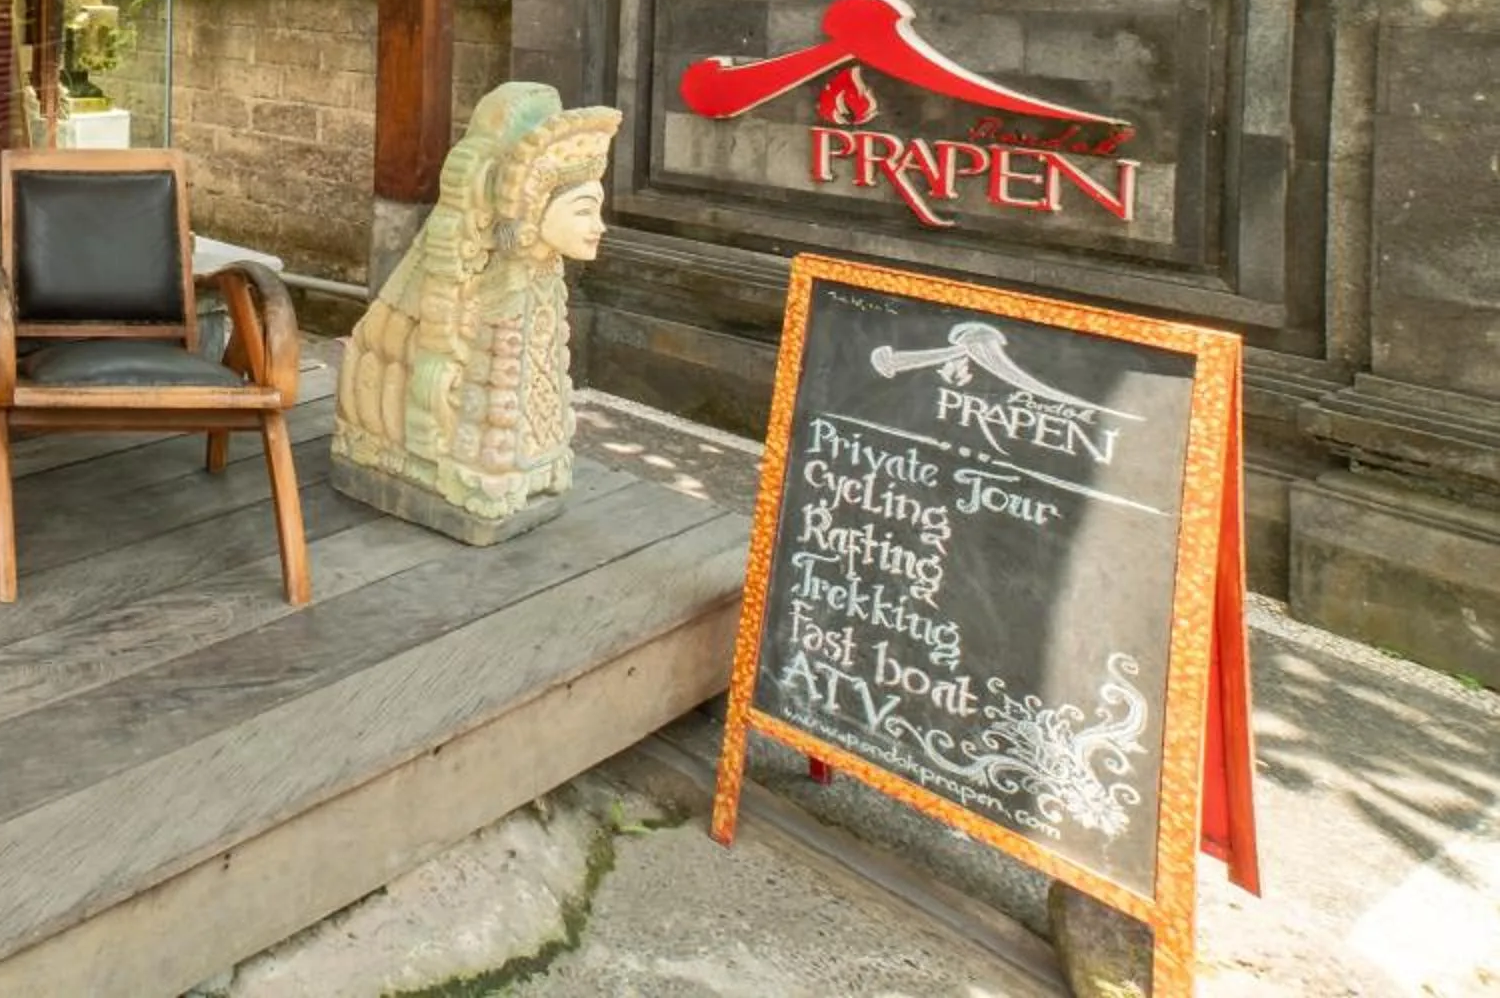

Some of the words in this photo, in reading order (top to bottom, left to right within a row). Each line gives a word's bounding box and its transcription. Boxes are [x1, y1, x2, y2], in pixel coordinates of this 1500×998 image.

[810, 127, 1141, 226] PRAPEN
[805, 418, 938, 487] Private
[953, 468, 1062, 525] Tour
[938, 387, 1120, 465] PRAPEN
[797, 498, 943, 610] Rafting
[788, 598, 856, 666] Fast
[872, 641, 978, 716] boat
[791, 552, 960, 670] Trekking
[780, 650, 901, 724] ATV
